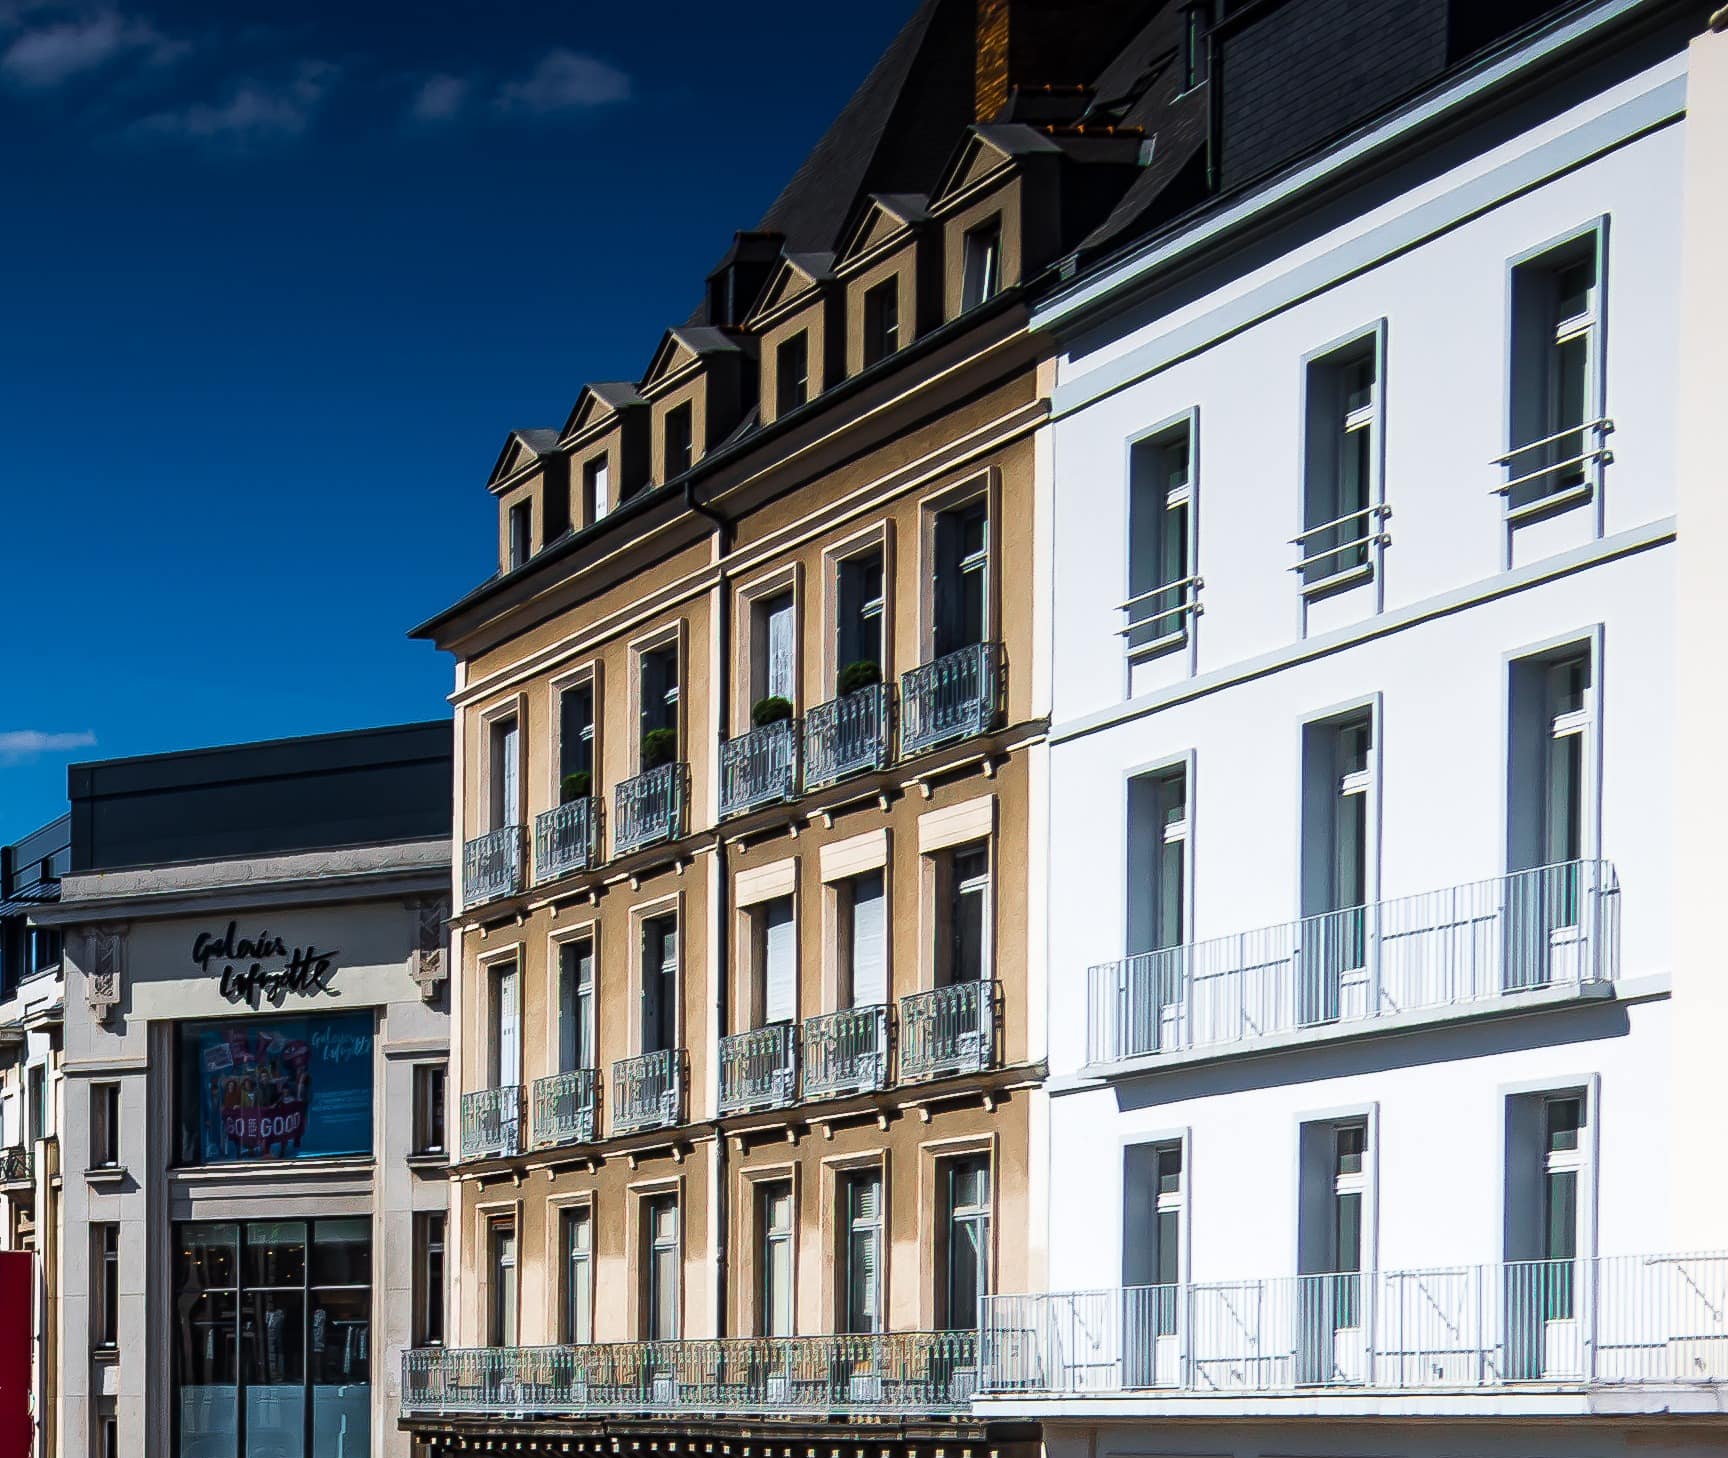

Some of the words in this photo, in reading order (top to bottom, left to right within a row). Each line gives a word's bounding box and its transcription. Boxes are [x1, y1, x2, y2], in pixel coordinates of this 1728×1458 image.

[192, 920, 287, 972] Galeries
[219, 946, 340, 1005] Lafayette
[260, 1112, 302, 1137] GOOD
